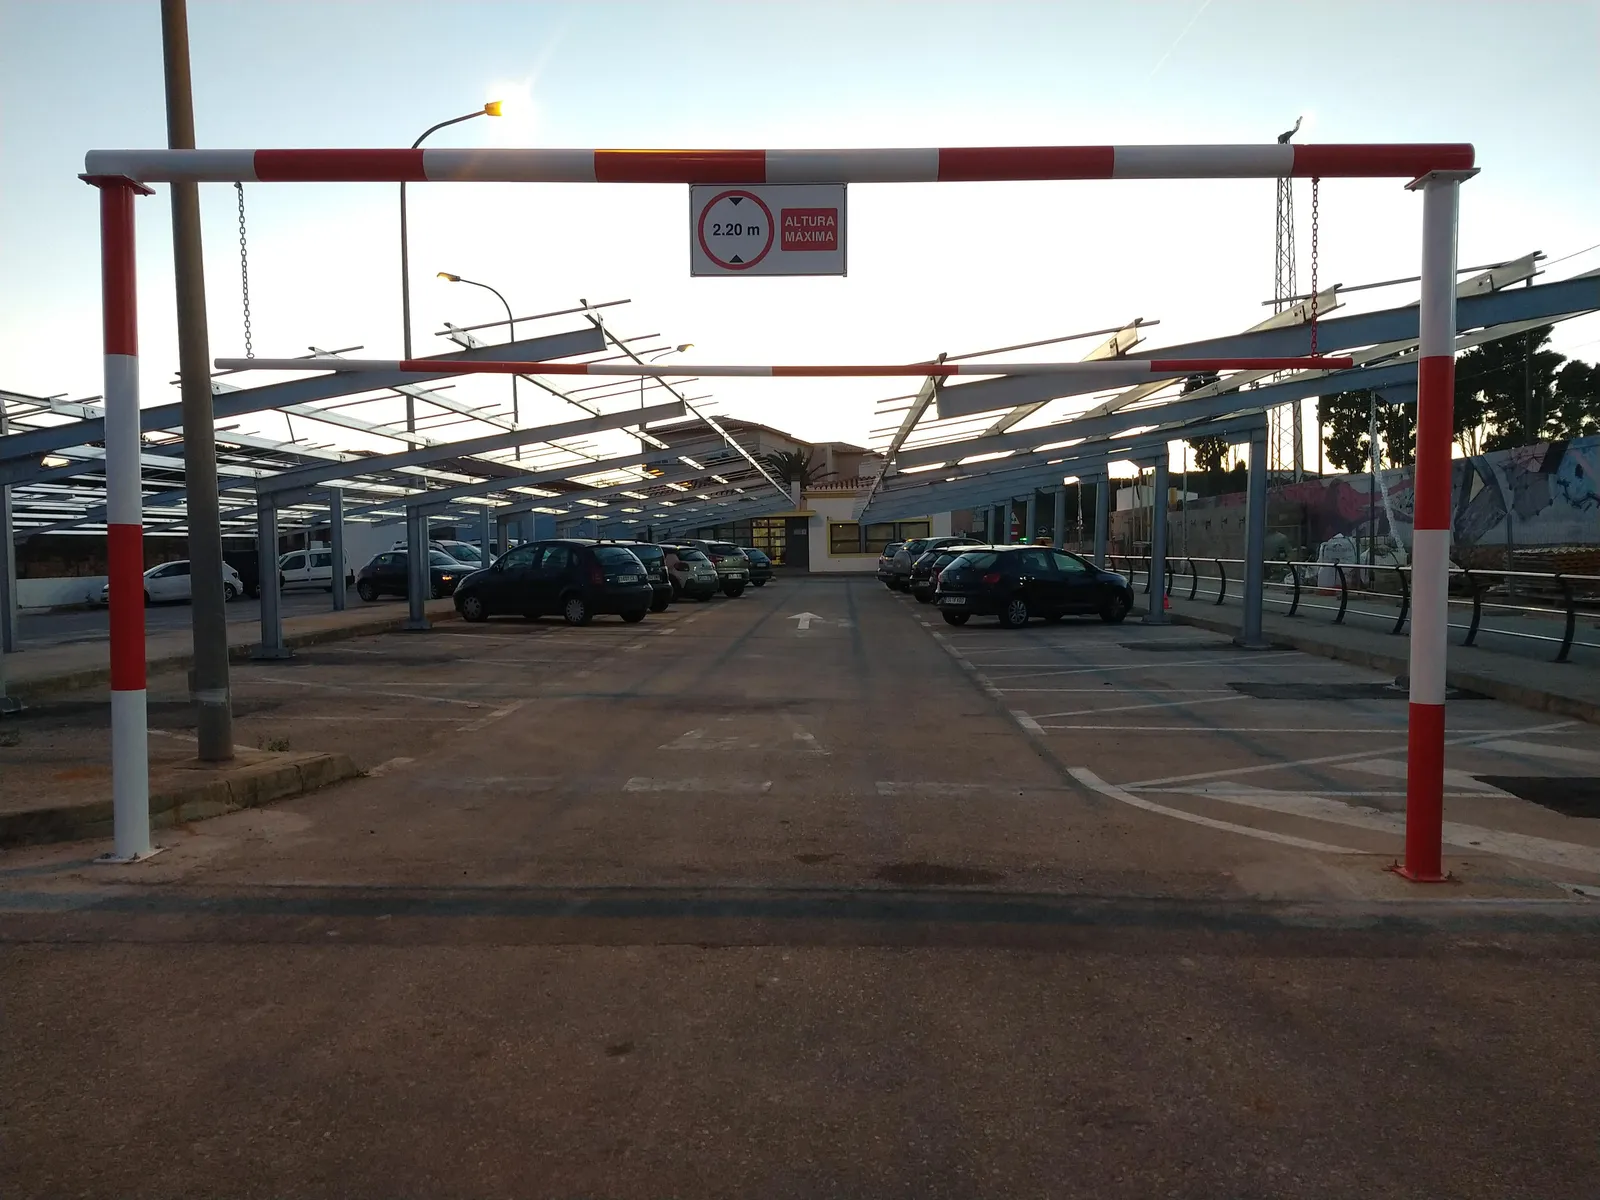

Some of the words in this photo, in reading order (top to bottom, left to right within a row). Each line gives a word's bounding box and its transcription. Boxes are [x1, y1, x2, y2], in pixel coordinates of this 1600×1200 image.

[785, 215, 835, 227] ALTURA
[712, 223, 743, 236] 2.20
[747, 225, 760, 236] m
[785, 229, 834, 242] MÁXIMA
